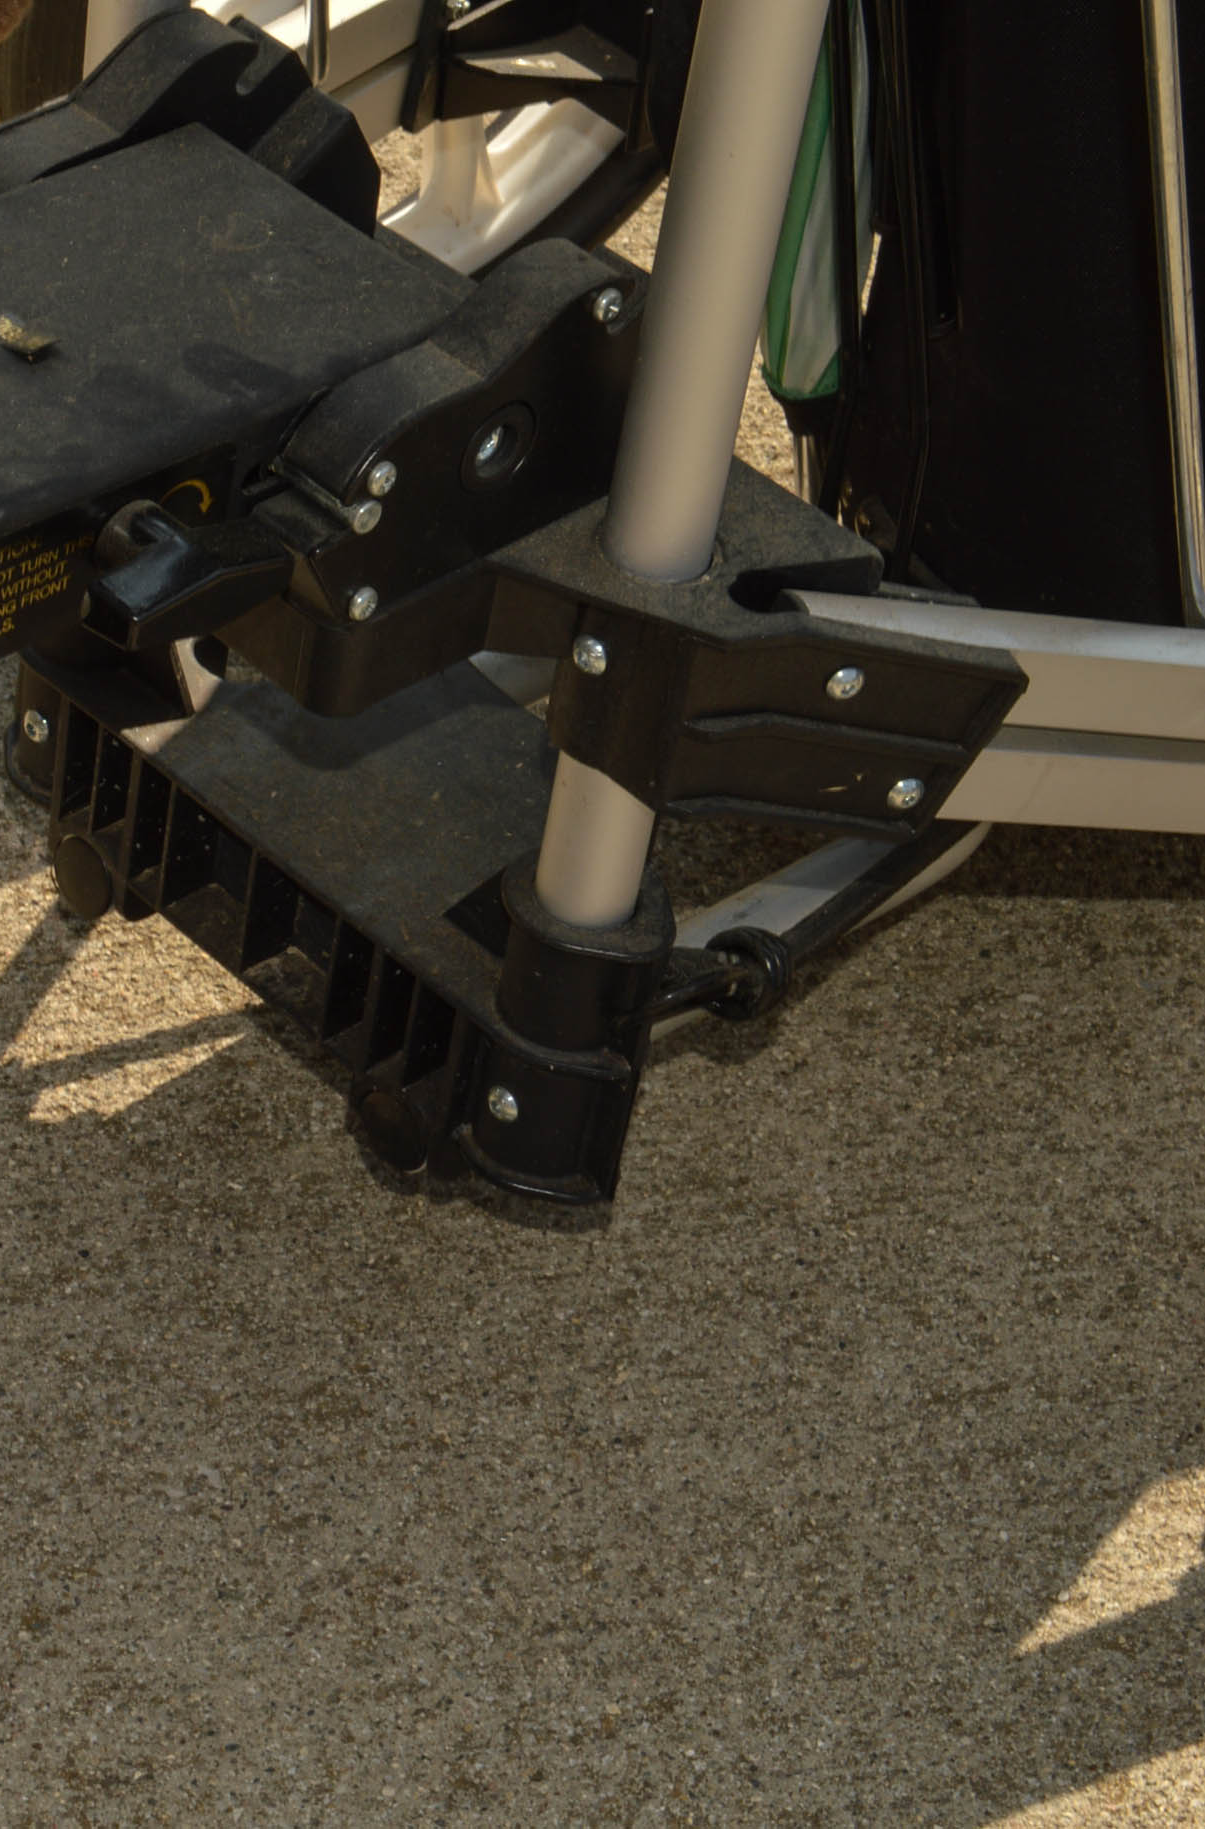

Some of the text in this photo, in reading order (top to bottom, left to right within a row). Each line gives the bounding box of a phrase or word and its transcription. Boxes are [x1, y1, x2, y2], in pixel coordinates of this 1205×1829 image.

[22, 548, 60, 576] TURN
[1, 561, 67, 600] WITHOUT
[21, 576, 71, 608] FRONT
